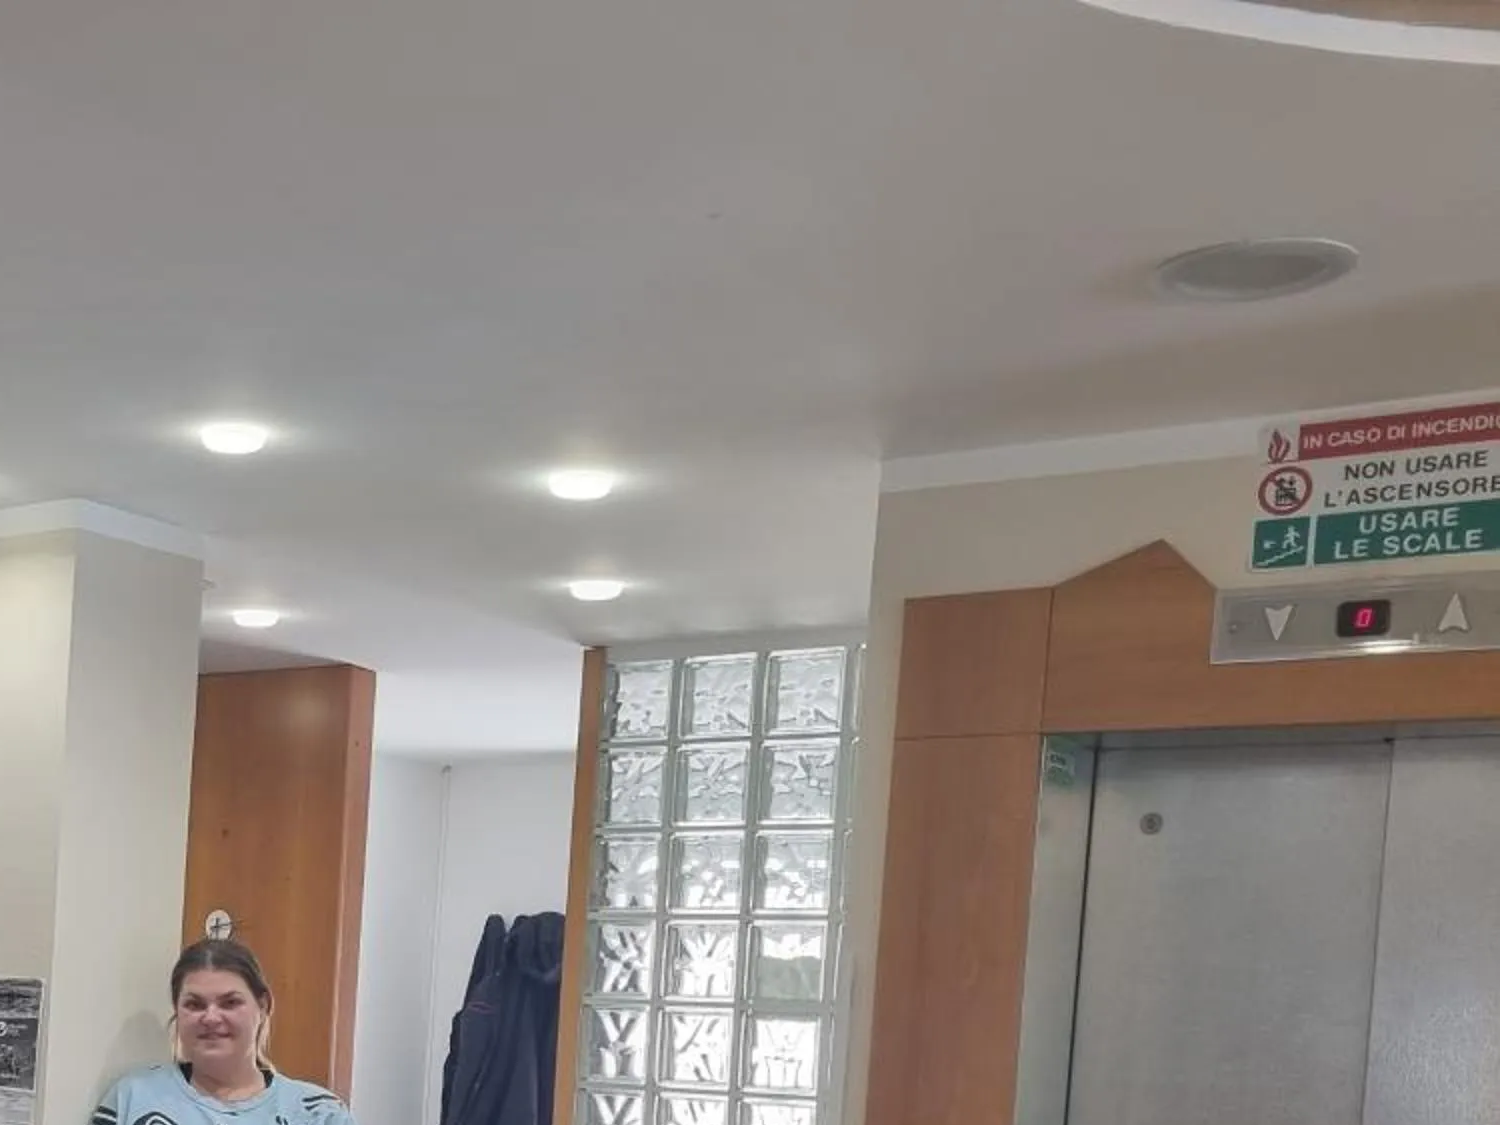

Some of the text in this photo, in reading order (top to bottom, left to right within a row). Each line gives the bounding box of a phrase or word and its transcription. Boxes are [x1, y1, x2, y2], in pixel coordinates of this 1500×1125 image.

[1303, 434, 1322, 449] IN
[1327, 429, 1381, 445] CASO
[1387, 425, 1405, 440] DI
[1344, 450, 1489, 480] NON USARE
[1359, 507, 1461, 534] USARE
[1334, 528, 1484, 559] LE SCALE
[1355, 607, 1373, 629] 0
